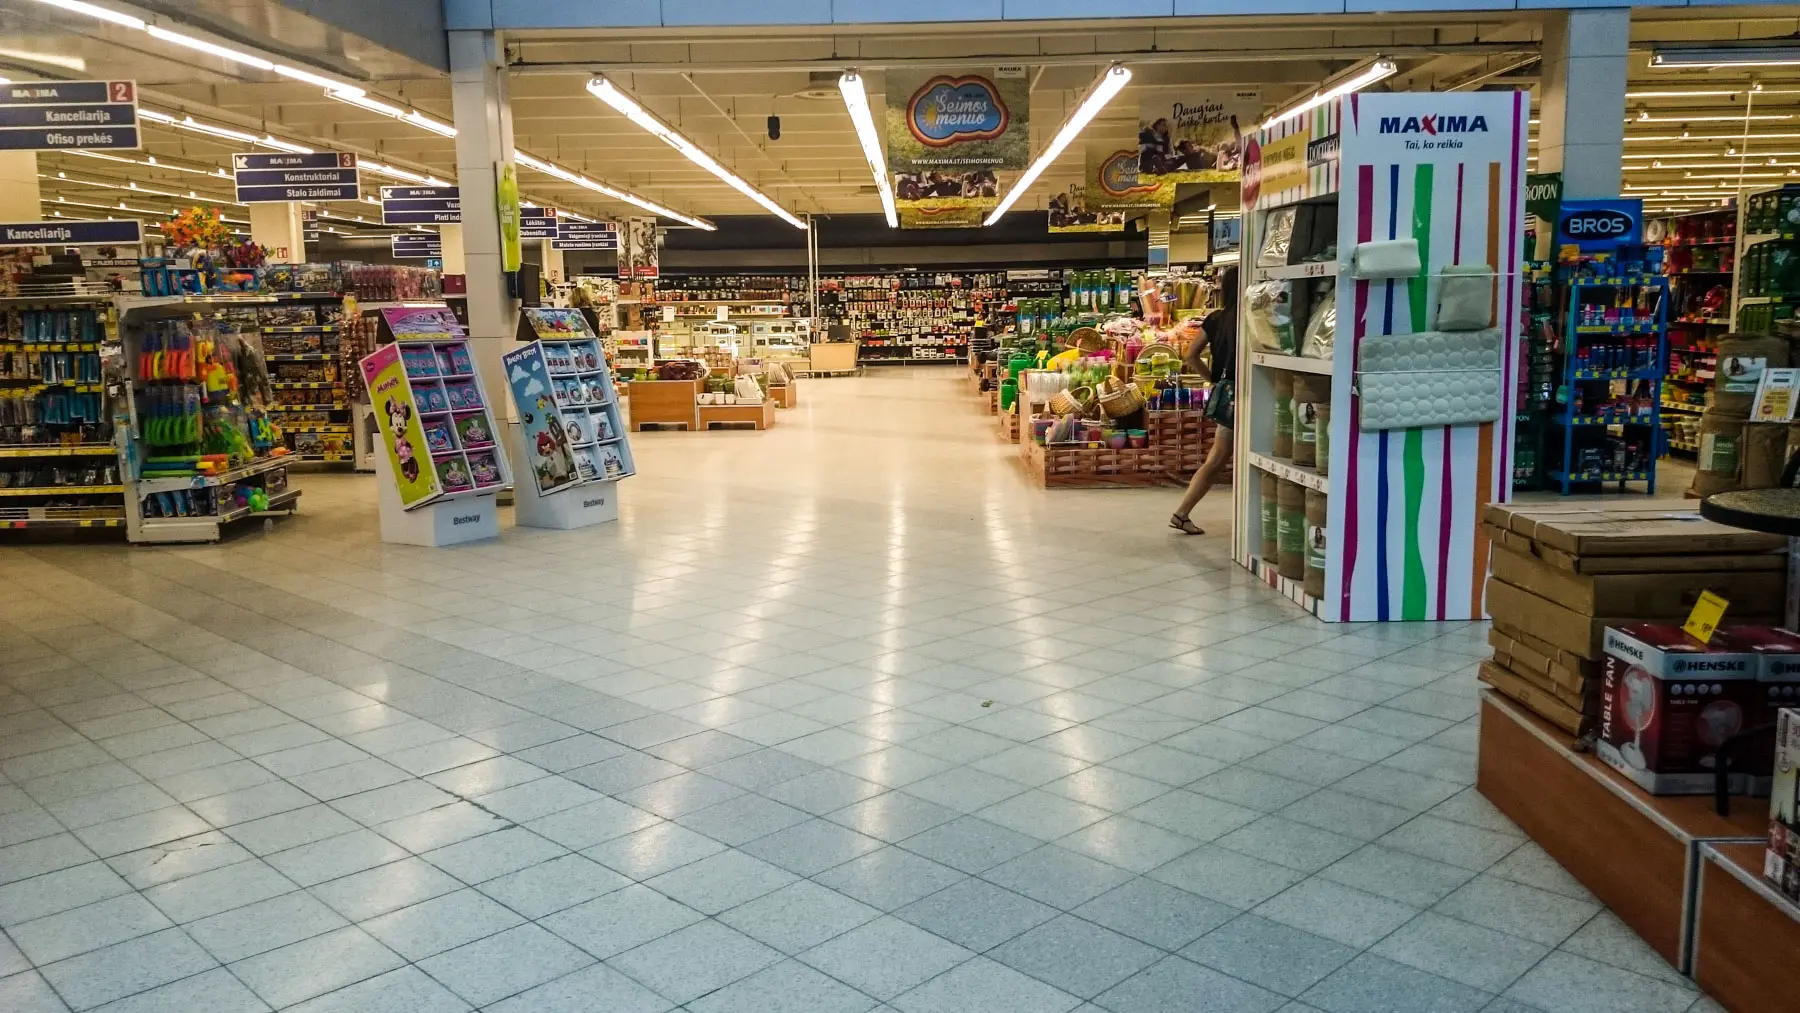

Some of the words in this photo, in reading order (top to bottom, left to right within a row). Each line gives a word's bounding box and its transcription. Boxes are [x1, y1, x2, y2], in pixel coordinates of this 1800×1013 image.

[115, 83, 128, 101] 2
[46, 109, 111, 123] Kanceliarija
[1172, 98, 1224, 120] Daugiau
[1379, 113, 1488, 135] MAXIMA
[46, 133, 75, 145] Ofiso
[77, 132, 113, 146] prekės
[1405, 140, 1421, 150] Tai,
[1423, 140, 1434, 149] ko
[1437, 140, 1463, 149] reikia
[343, 153, 351, 167] 3
[284, 172, 340, 182] Konstruktoriai
[286, 188, 308, 197] Stalo
[308, 187, 341, 197] žaidimai
[434, 213, 449, 221] Pinti
[548, 208, 554, 217] 5
[609, 223, 615, 231] 6
[1569, 217, 1625, 234] BROS
[7, 227, 71, 241] Kanceliarija
[583, 497, 605, 508] Bestway
[453, 514, 481, 526] Bestway
[1614, 640, 1644, 660] HENSKE
[1605, 657, 1616, 688] FAN
[1687, 661, 1746, 671] HENSKE
[1602, 693, 1613, 740] TABLE
